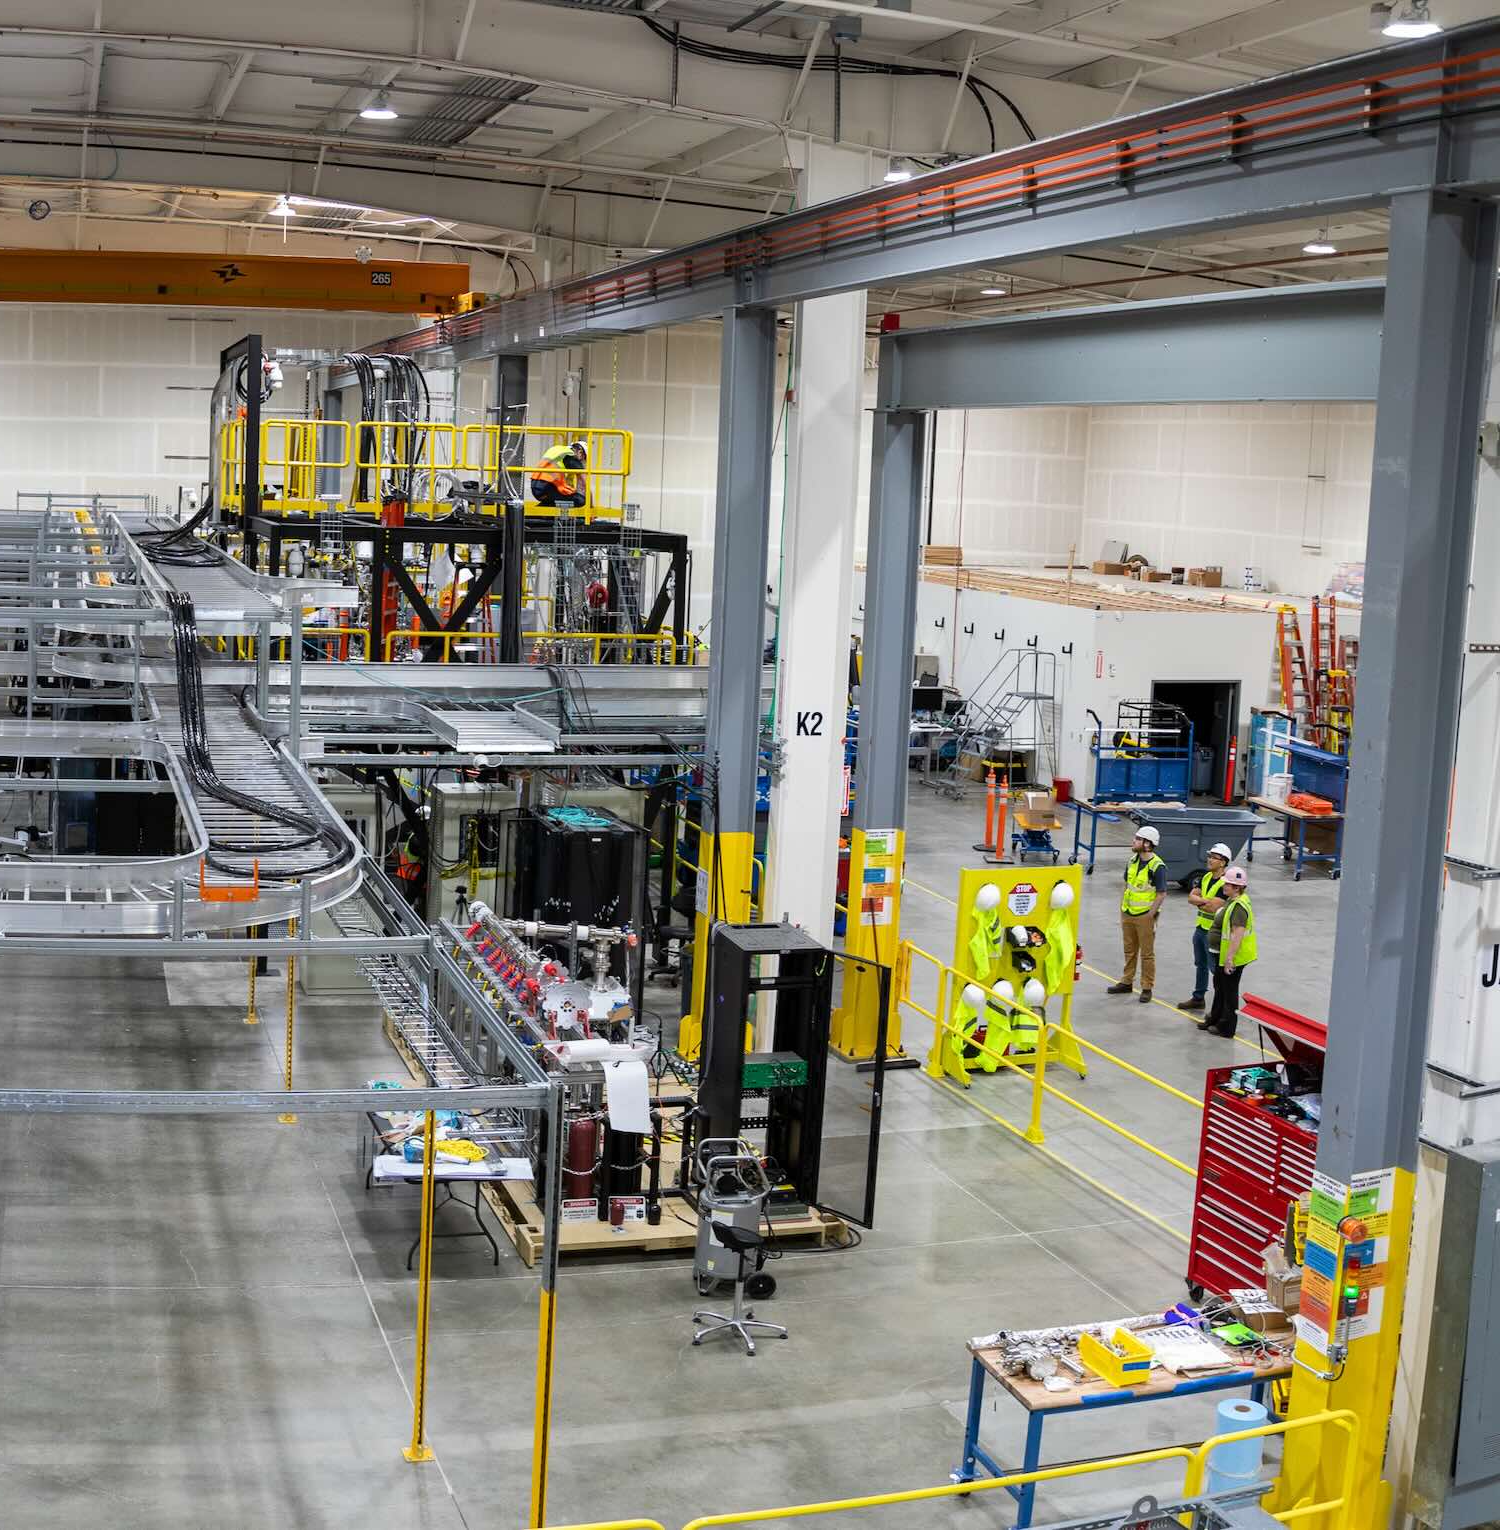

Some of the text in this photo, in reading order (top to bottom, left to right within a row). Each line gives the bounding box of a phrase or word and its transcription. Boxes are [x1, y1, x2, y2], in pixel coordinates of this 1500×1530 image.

[372, 273, 391, 284] 265
[796, 711, 823, 736] K2
[1482, 943, 1500, 988] J
